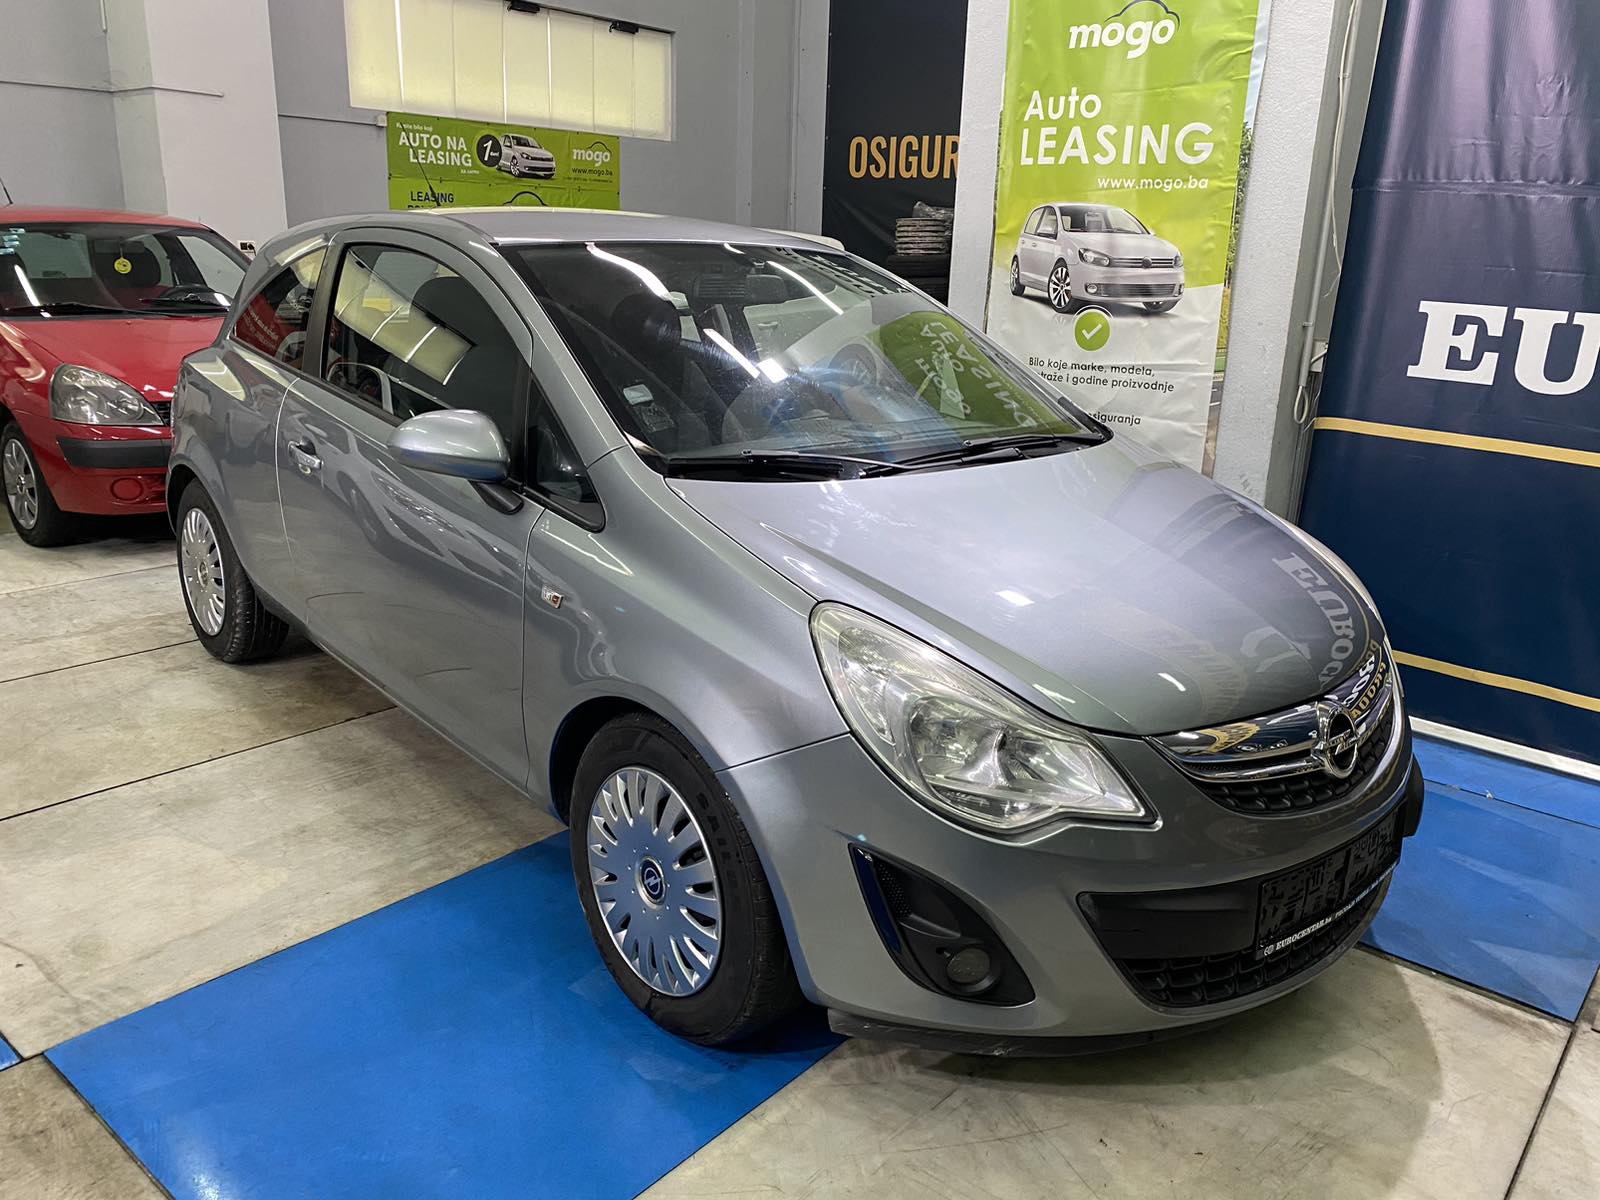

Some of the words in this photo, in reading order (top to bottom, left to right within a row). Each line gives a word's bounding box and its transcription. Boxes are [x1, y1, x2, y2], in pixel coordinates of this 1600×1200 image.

[1068, 16, 1176, 59] mogo
[1023, 87, 1102, 122] Auto
[399, 131, 442, 149] AUTO
[446, 136, 467, 151] NA
[483, 140, 493, 161] 1
[1019, 122, 1215, 166] LEASING
[409, 148, 472, 167] LEASING
[572, 148, 611, 167] mogo
[848, 134, 960, 180] OSIGUR
[572, 167, 613, 177] www.mogo.ba
[1097, 175, 1209, 192] www.mogo.ba
[410, 190, 455, 203] LEASING
[1406, 300, 1600, 396] EU
[1029, 357, 1045, 367] Bilo
[1047, 358, 1068, 373] koje
[1071, 361, 1107, 374] marke,
[1110, 365, 1155, 378] modela,
[1038, 371, 1064, 383] traže
[1066, 373, 1070, 383] i
[1072, 375, 1109, 386] godine
[1111, 379, 1175, 394] proizvodnje
[1089, 411, 1141, 427] siguranja
